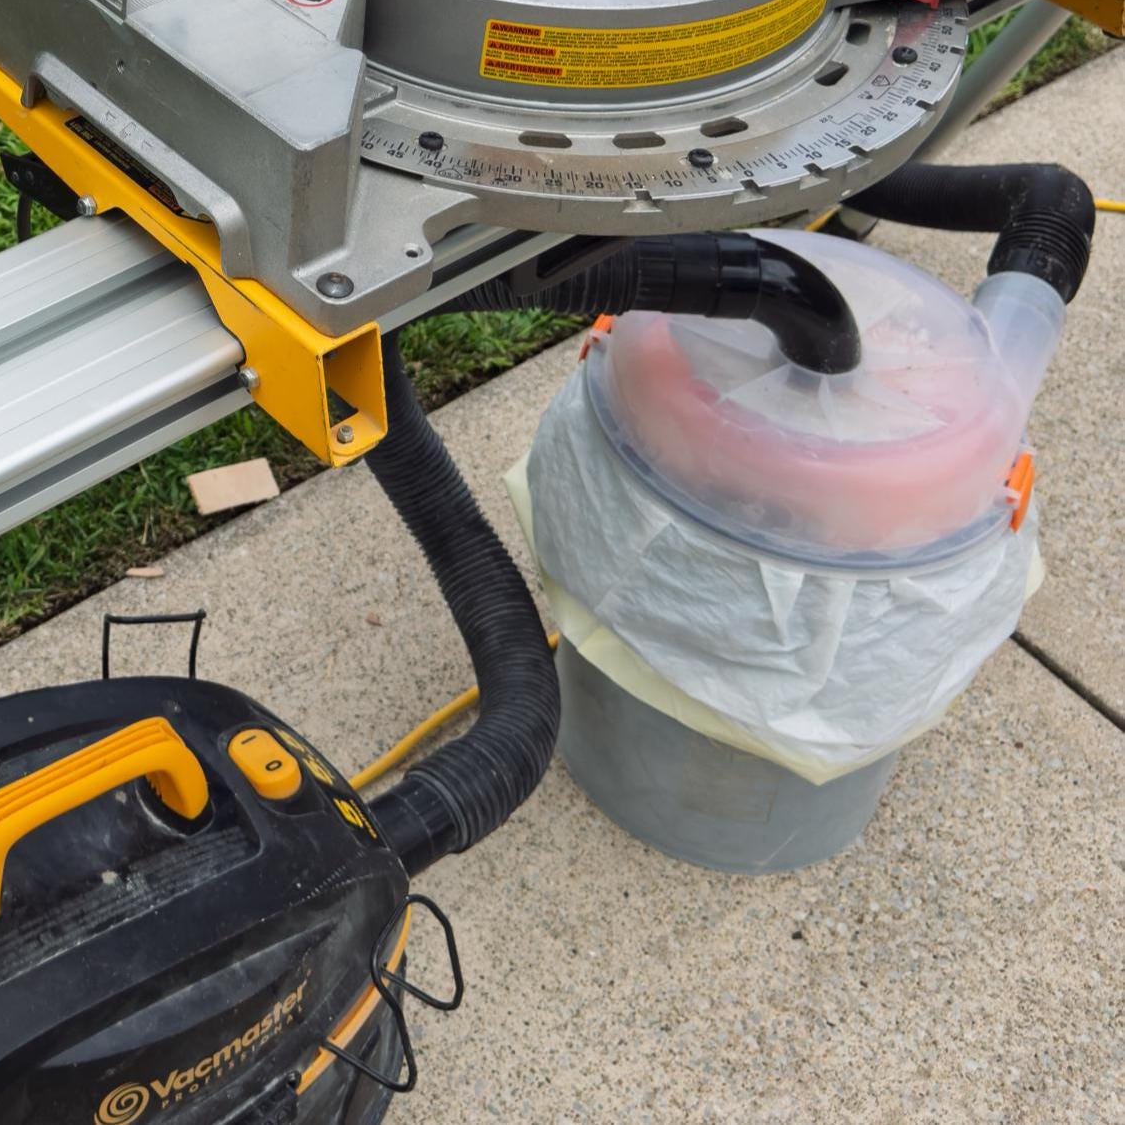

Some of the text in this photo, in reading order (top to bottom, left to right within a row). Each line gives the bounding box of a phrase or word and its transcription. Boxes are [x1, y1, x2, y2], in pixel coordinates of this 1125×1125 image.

[500, 24, 541, 37] WARNING
[941, 24, 953, 36] 50
[936, 43, 949, 54] 45
[928, 61, 942, 73] 40
[917, 78, 932, 90] 35
[902, 95, 917, 106] 30
[882, 111, 898, 122] 25
[860, 125, 877, 136] 20
[835, 138, 852, 149] 15
[387, 149, 405, 158] 45
[805, 150, 823, 160] 10
[424, 159, 442, 168] 40
[777, 161, 788, 170] 5
[505, 174, 522, 183] 30
[586, 180, 604, 189] 20
[625, 180, 643, 189] 15
[150, 978, 308, 1098] Vacmaster
